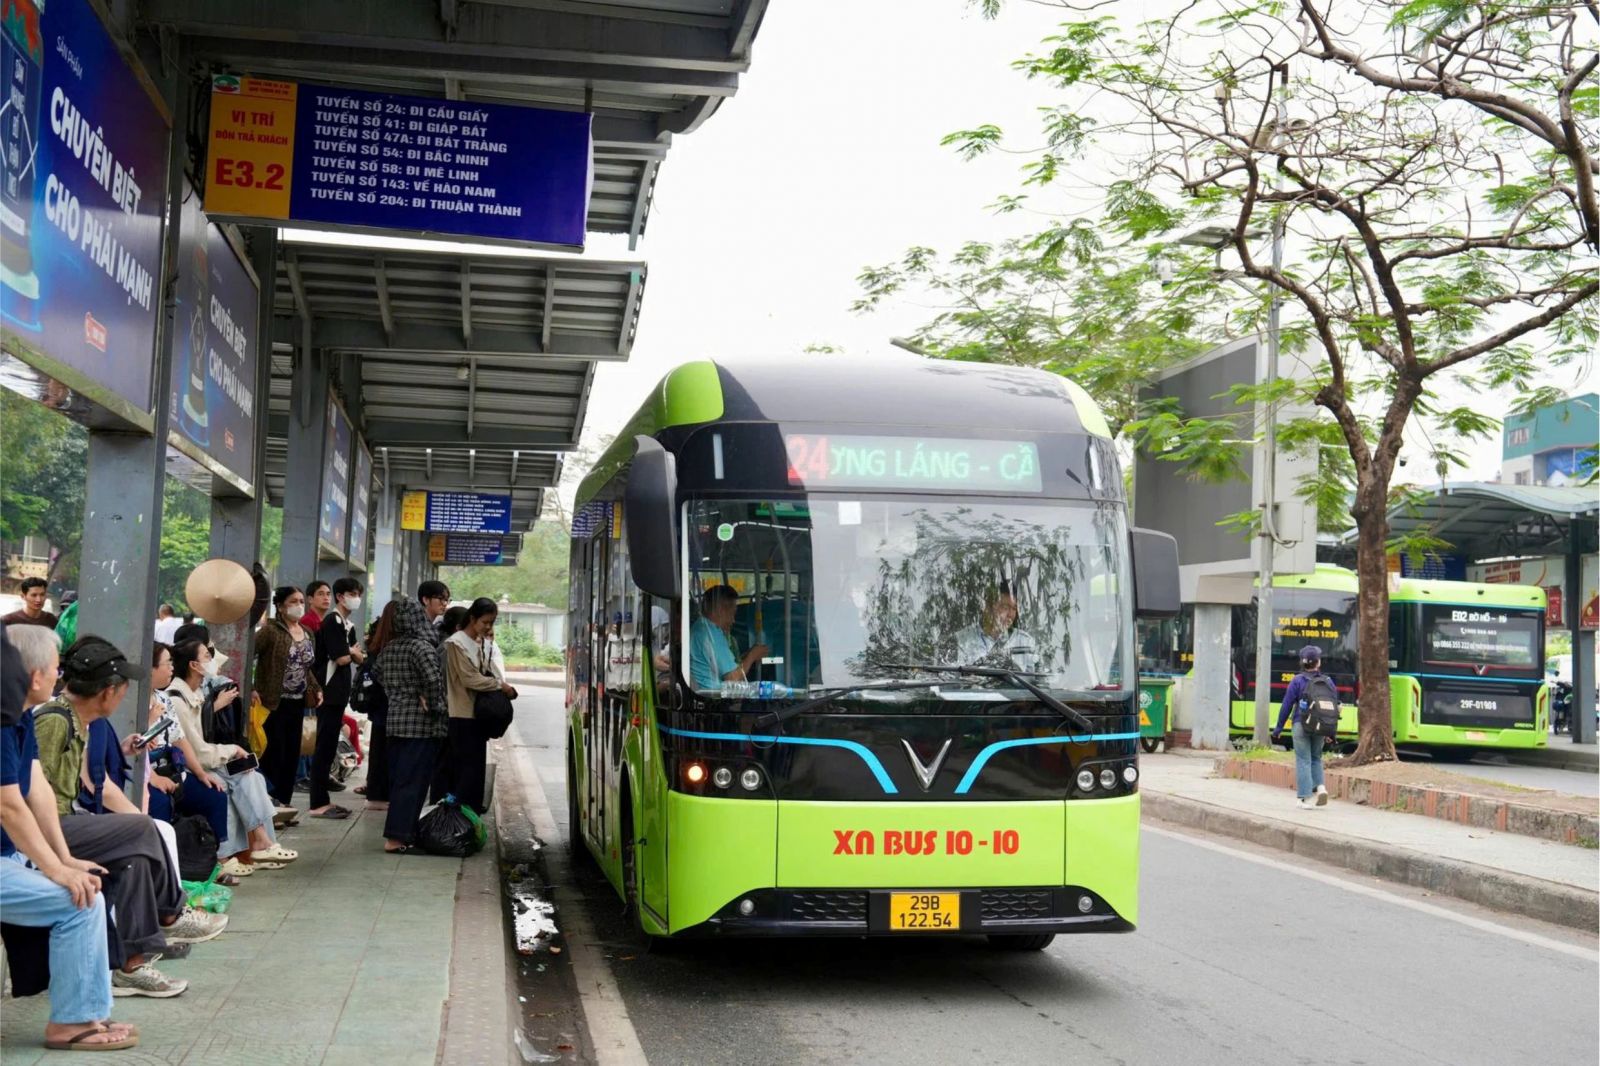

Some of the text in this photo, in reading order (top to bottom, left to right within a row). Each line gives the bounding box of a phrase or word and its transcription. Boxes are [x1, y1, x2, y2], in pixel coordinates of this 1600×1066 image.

[232, 110, 275, 127] VỊ TRÍ
[316, 95, 360, 110] TUYẾN
[364, 99, 383, 112] SỐ
[386, 103, 406, 114] 24:
[410, 106, 423, 117] ĐI
[458, 109, 489, 122] GIẤY
[315, 110, 358, 125] TUYẾN
[362, 114, 382, 127] SỐ
[384, 118, 405, 129] 41:
[409, 121, 422, 131] ĐI
[427, 122, 458, 134] GIÁP
[315, 125, 358, 138] TUYẾN
[362, 128, 380, 140] SỐ
[384, 132, 413, 144] 47A:
[417, 136, 431, 145] ĐI
[50, 86, 142, 224] CHUYÊN BIỆT
[313, 140, 357, 153] TUYẾN
[361, 143, 379, 155] SỐ
[383, 148, 403, 158] 54:
[407, 150, 421, 160] ĐI
[456, 156, 489, 166] NINH
[215, 158, 285, 190] E3.2
[312, 155, 479, 181] TUYẾN SỐ 58: ĐI MÊ LINH
[312, 171, 355, 184] TUYẾN
[359, 174, 378, 187] SỐ
[382, 178, 409, 190] 143:
[465, 187, 496, 198] NAM
[311, 188, 354, 201] TUYẾN
[358, 191, 376, 203] SỐ
[380, 195, 408, 206] 204:
[412, 198, 425, 208] ĐI
[430, 199, 474, 213] THUẬN
[45, 174, 152, 311] CHO PHÁI MẠNH
[209, 348, 222, 387] CHO
[788, 435, 827, 479] 24
[895, 440, 969, 478] LÁNG
[1292, 617, 1308, 626] BUS
[1452, 610, 1467, 622] E02
[883, 830, 937, 855] BUS
[946, 830, 973, 855] 10
[993, 830, 1019, 855] 10
[910, 896, 940, 911] 29B
[899, 912, 952, 928] 122.54
